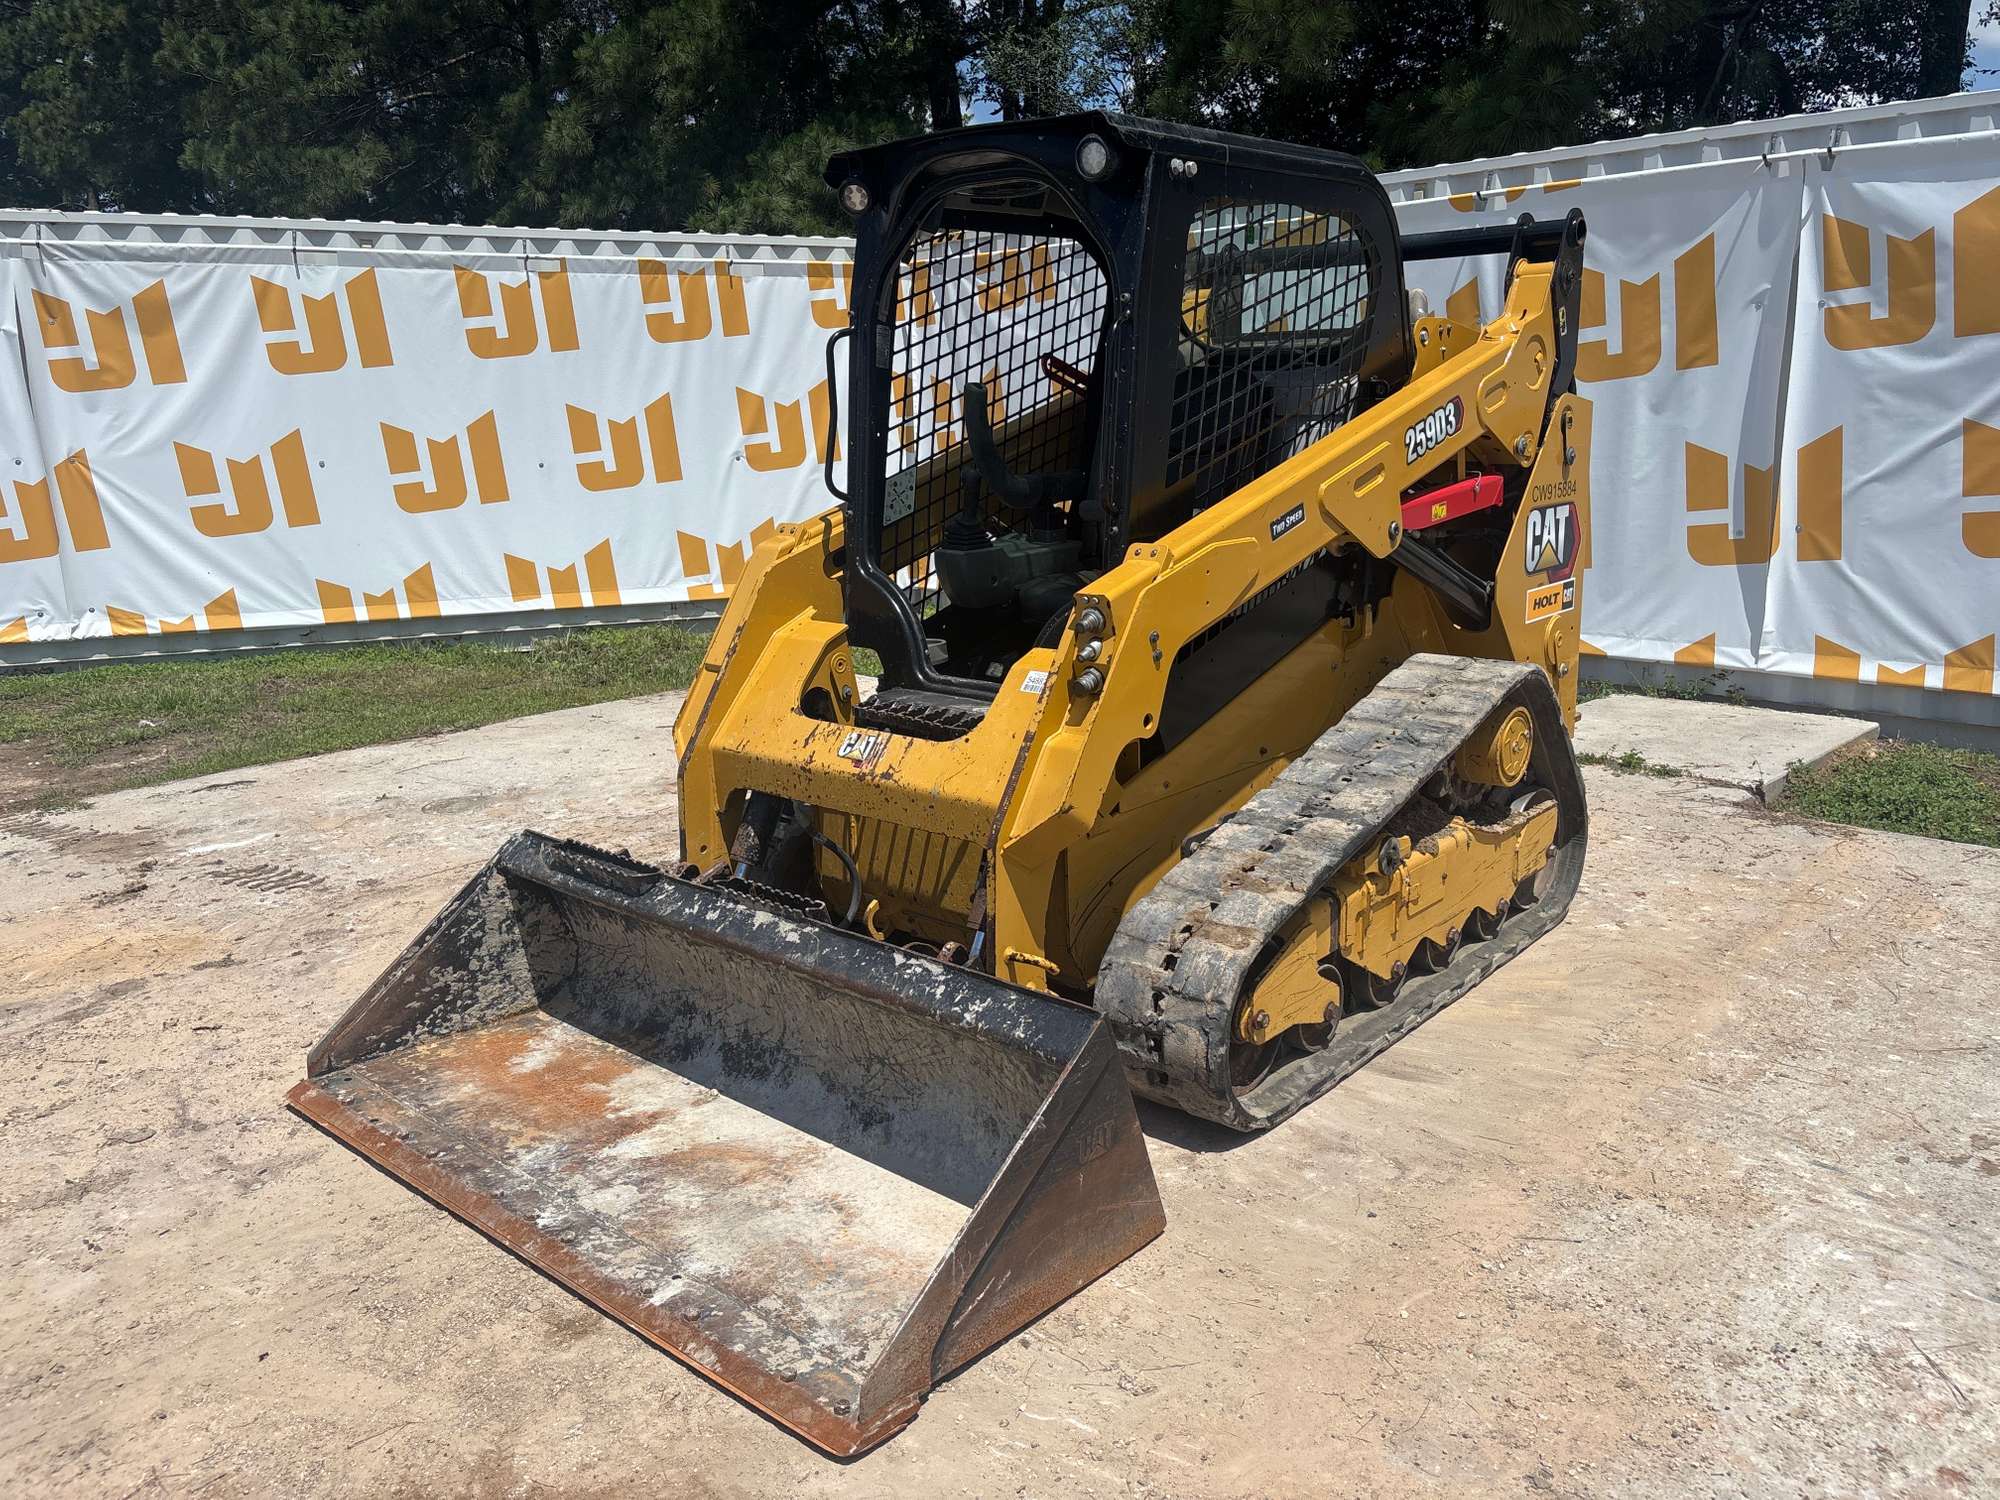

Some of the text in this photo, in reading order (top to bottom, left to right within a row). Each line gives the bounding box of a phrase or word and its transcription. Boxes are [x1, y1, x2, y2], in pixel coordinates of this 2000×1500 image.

[1405, 402, 1457, 465] 259D3
[1532, 480, 1576, 502] CW915884
[1526, 504, 1570, 572] CAT
[1533, 592, 1560, 610] HOLT
[838, 731, 877, 760] CAT
